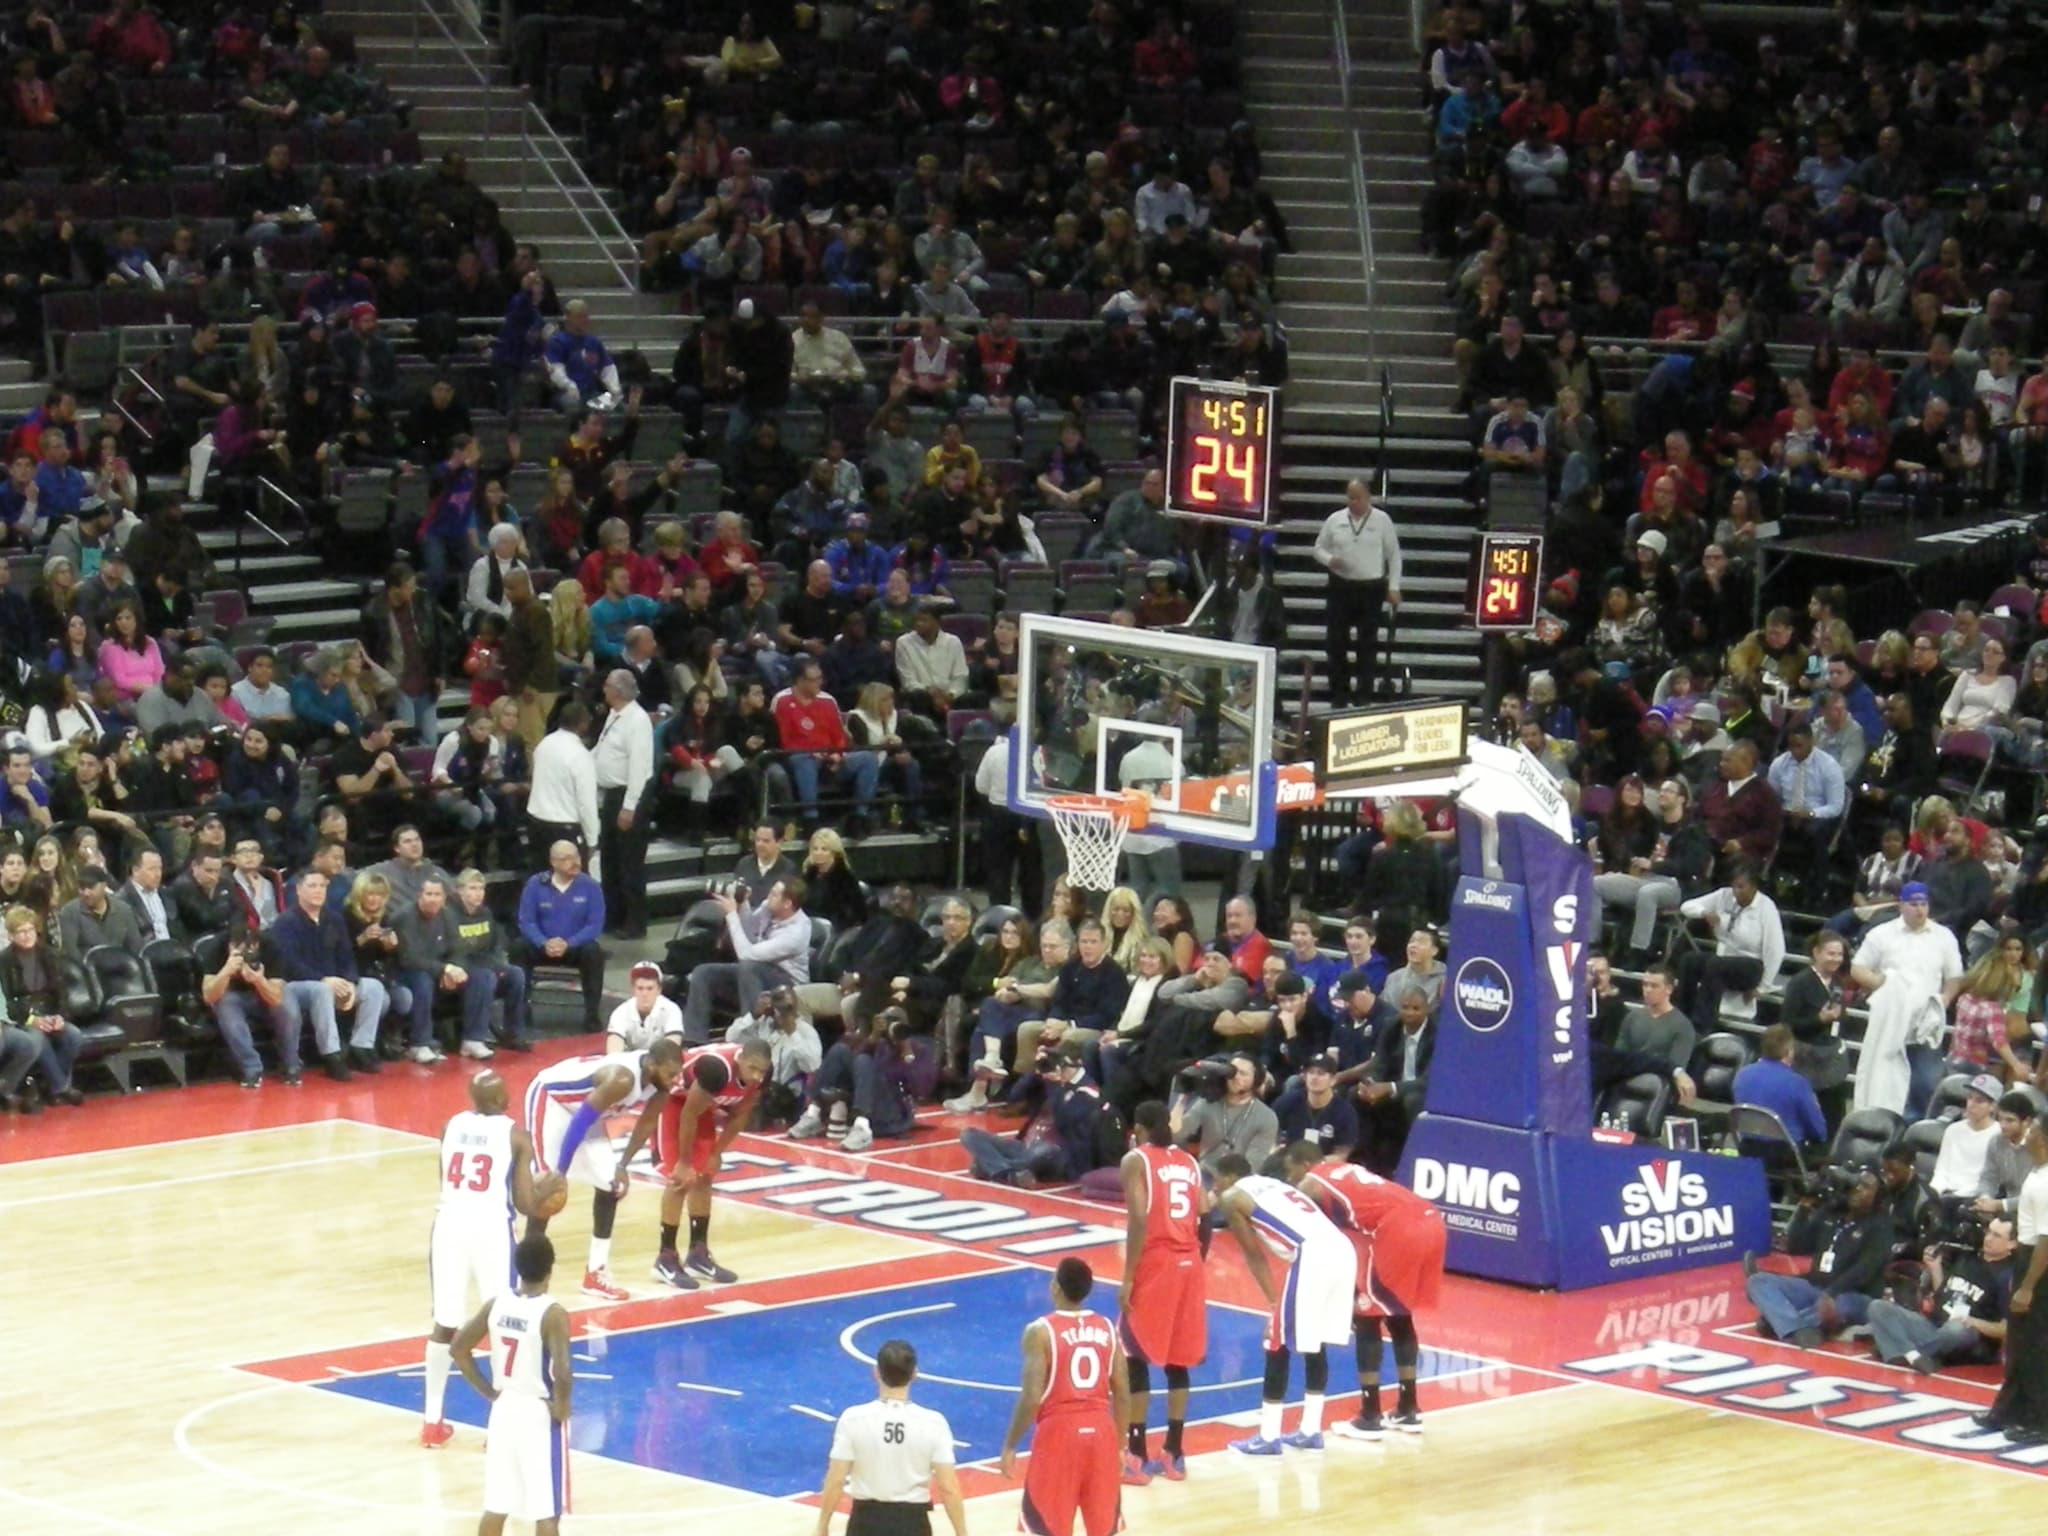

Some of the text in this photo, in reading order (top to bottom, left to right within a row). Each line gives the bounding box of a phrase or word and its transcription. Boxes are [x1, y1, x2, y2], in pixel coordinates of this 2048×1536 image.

[1204, 400, 1264, 437] 4:51
[1192, 436, 1254, 504] 24
[1493, 549, 1528, 574] 4:51
[1486, 578, 1518, 613] 24
[1339, 733, 1401, 761] LIQUIDATORS
[1350, 725, 1390, 745] LUMBER
[1277, 778, 1316, 803] Farm
[1463, 888, 1513, 911] SPALDING
[447, 1151, 494, 1193] 43
[1412, 1157, 1521, 1216] DMC
[1168, 1181, 1192, 1220] 5
[1447, 1213, 1484, 1230] MEDICAL
[1485, 1219, 1518, 1237] CENTER
[1600, 1204, 1735, 1256] VISION
[1609, 1253, 1641, 1269] OPTICAL
[1641, 1248, 1674, 1263] CENTERS
[501, 1335, 519, 1378] 7
[1069, 1346, 1100, 1389] 0
[1560, 1339, 2048, 1467] PISTO
[883, 1421, 905, 1444] 56
